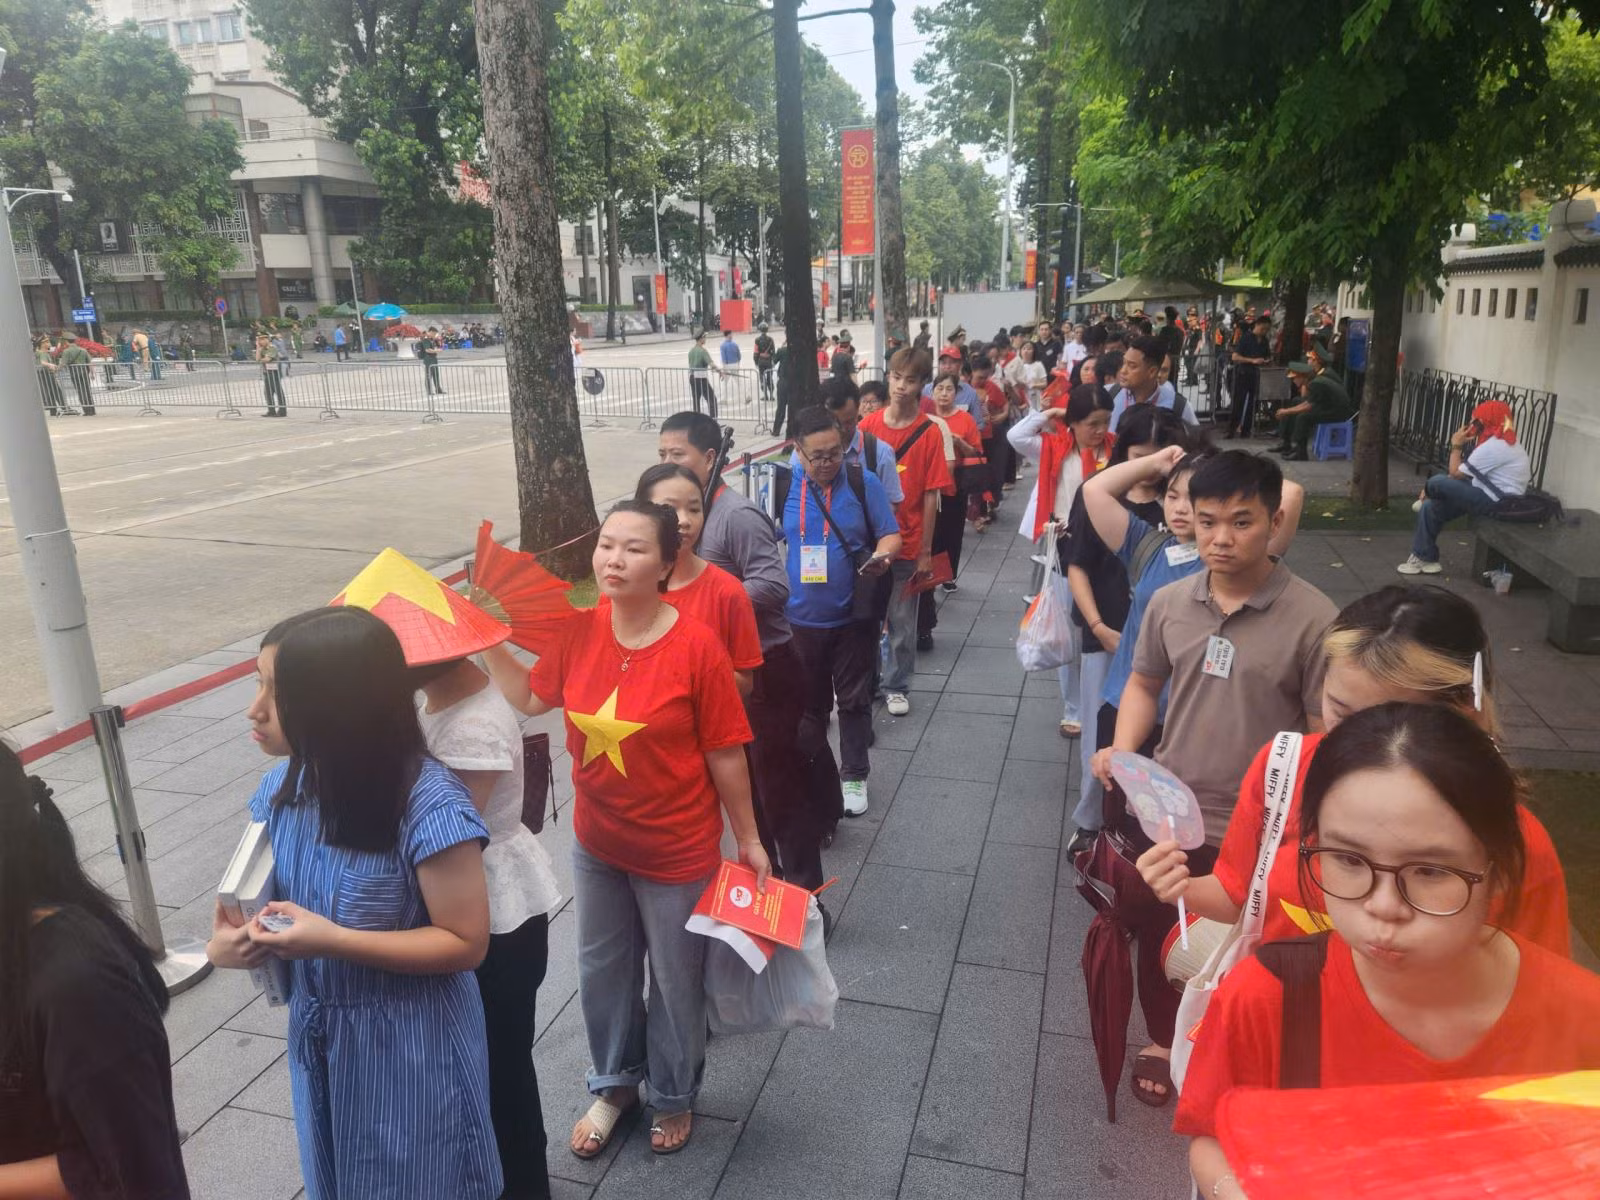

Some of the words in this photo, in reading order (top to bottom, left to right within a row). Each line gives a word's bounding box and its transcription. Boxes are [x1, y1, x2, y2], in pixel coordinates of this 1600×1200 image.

[1276, 734, 1290, 759] MIFFY
[1266, 767, 1281, 799] MIFFY
[1250, 888, 1262, 918] MIFFY
